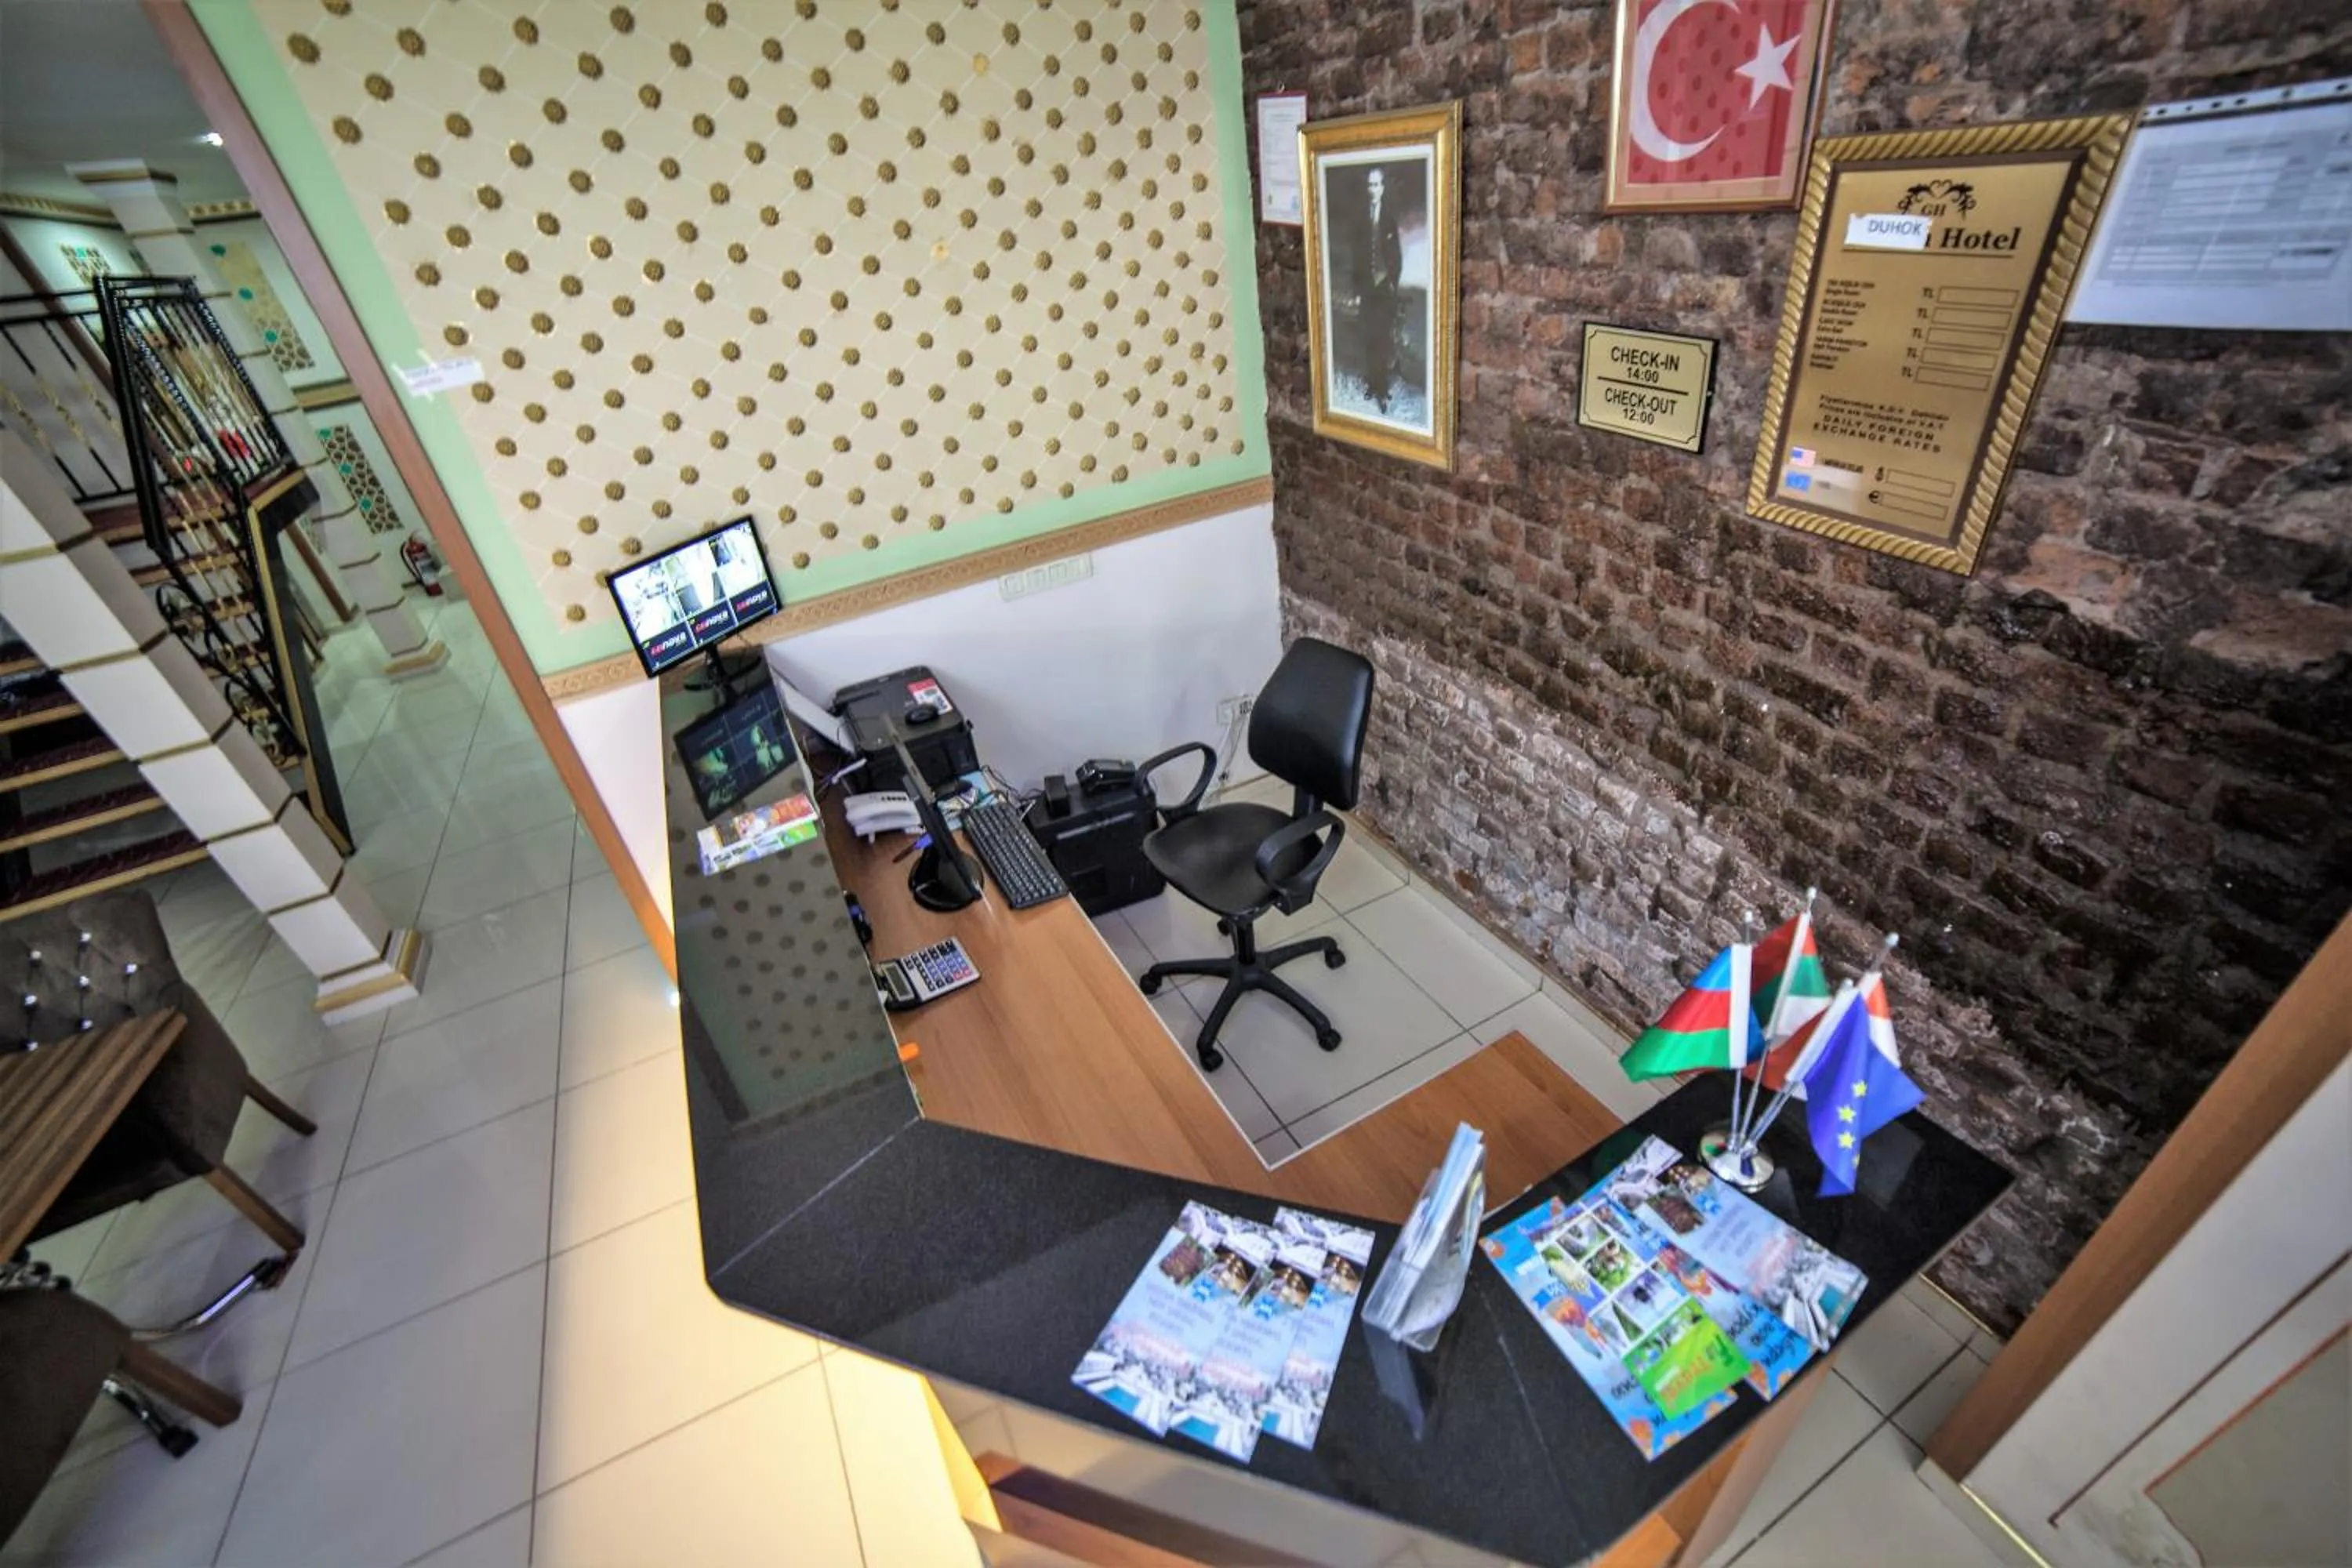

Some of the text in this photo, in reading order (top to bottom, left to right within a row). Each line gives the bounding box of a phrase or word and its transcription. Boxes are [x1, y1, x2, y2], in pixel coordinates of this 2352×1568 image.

[1867, 220, 1923, 235] DUHOK
[1940, 227, 2022, 251] Hotel
[1610, 345, 1680, 372] CHECK-IN
[1627, 366, 1659, 383] 14:00
[1605, 387, 1678, 416] CHECK-OUT
[1623, 408, 1655, 425] 12:00
[1823, 415, 1935, 441] DAILY FOREIGN
[1813, 422, 1941, 453] EXCHANGE RATES
